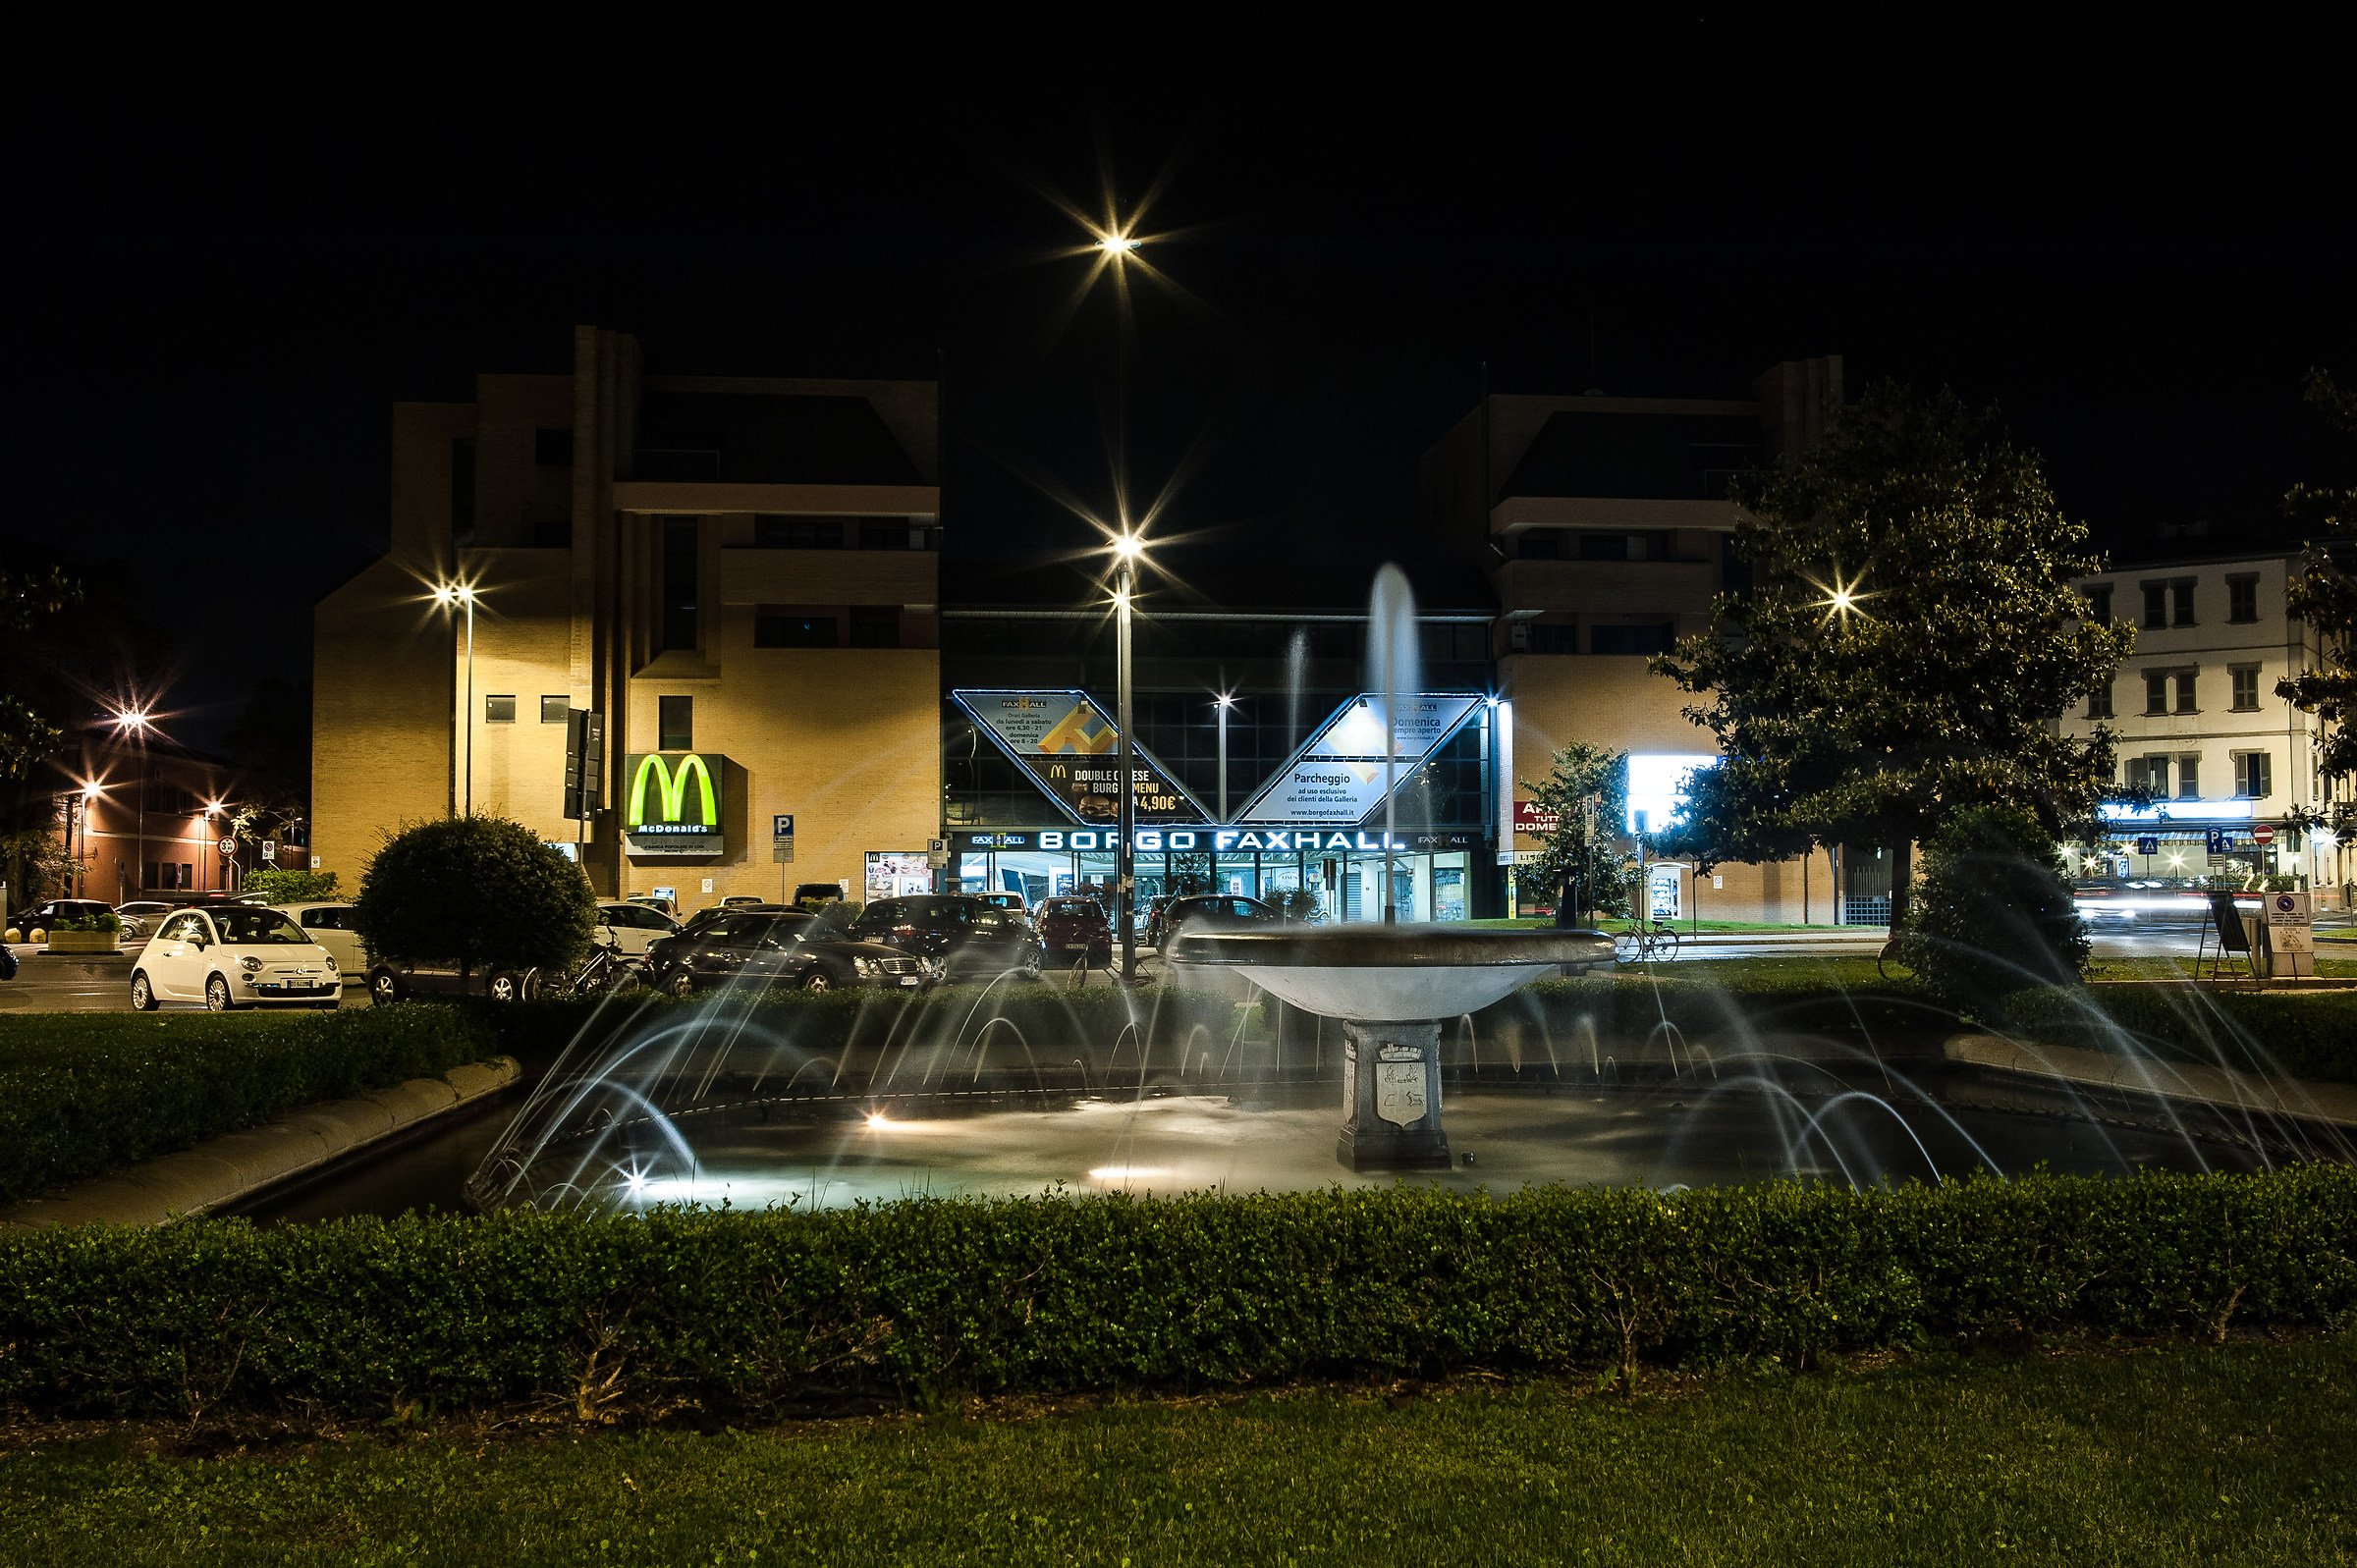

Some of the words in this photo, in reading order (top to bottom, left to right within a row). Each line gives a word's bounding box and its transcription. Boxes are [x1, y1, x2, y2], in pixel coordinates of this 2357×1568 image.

[1002, 697, 1046, 711] FAXHALL
[1417, 727, 1441, 735] aperto
[1074, 770, 1112, 782] DOUBLE
[1114, 770, 1149, 782] CESE
[1294, 773, 1350, 785] Parcheggio
[1092, 783, 1119, 793] BURG
[1133, 783, 1159, 793] MENU
[1140, 795, 1177, 812] 4,90€
[637, 825, 708, 834] McDonald's
[777, 817, 791, 834] P
[970, 832, 1024, 848] FAXHALL
[1040, 832, 1195, 849] BORGO
[1215, 832, 1405, 849] FAXHALL
